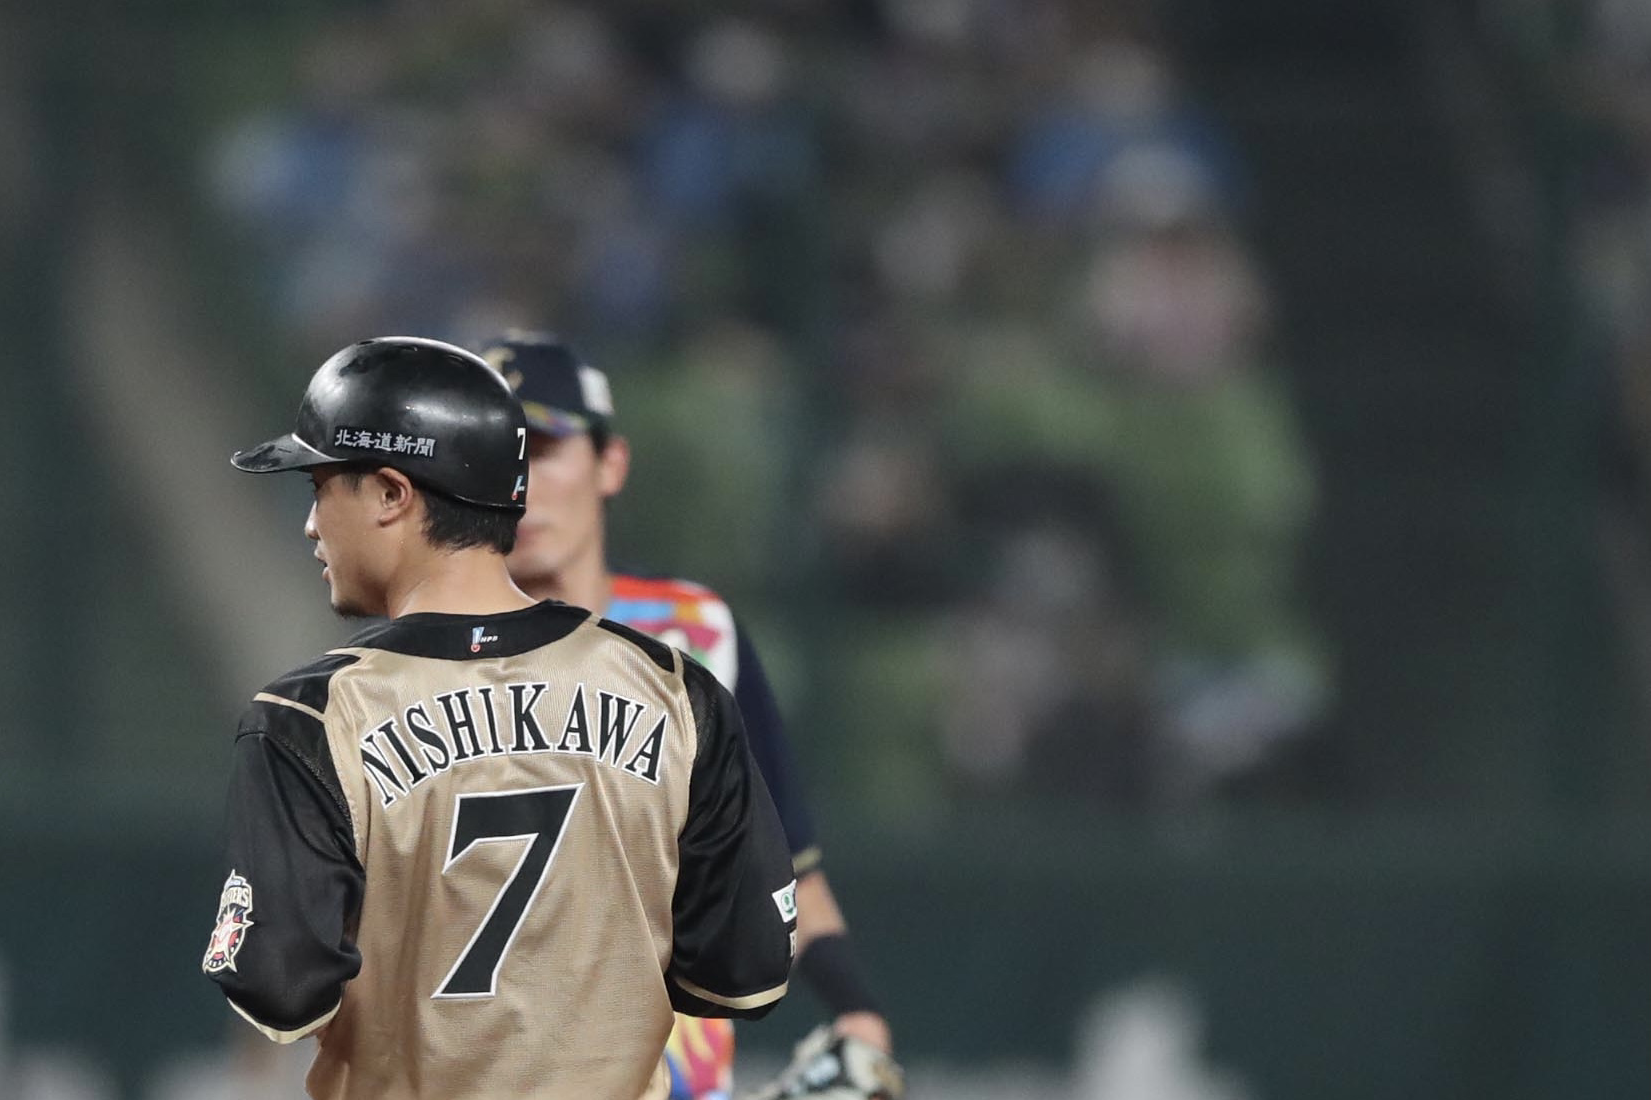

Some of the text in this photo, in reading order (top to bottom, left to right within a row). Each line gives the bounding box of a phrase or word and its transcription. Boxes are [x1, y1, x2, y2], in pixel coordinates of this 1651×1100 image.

[335, 429, 436, 457] 北海道新聞
[517, 427, 526, 460] 7
[360, 682, 670, 809] NISHIKAWA
[430, 782, 586, 1000] 7
